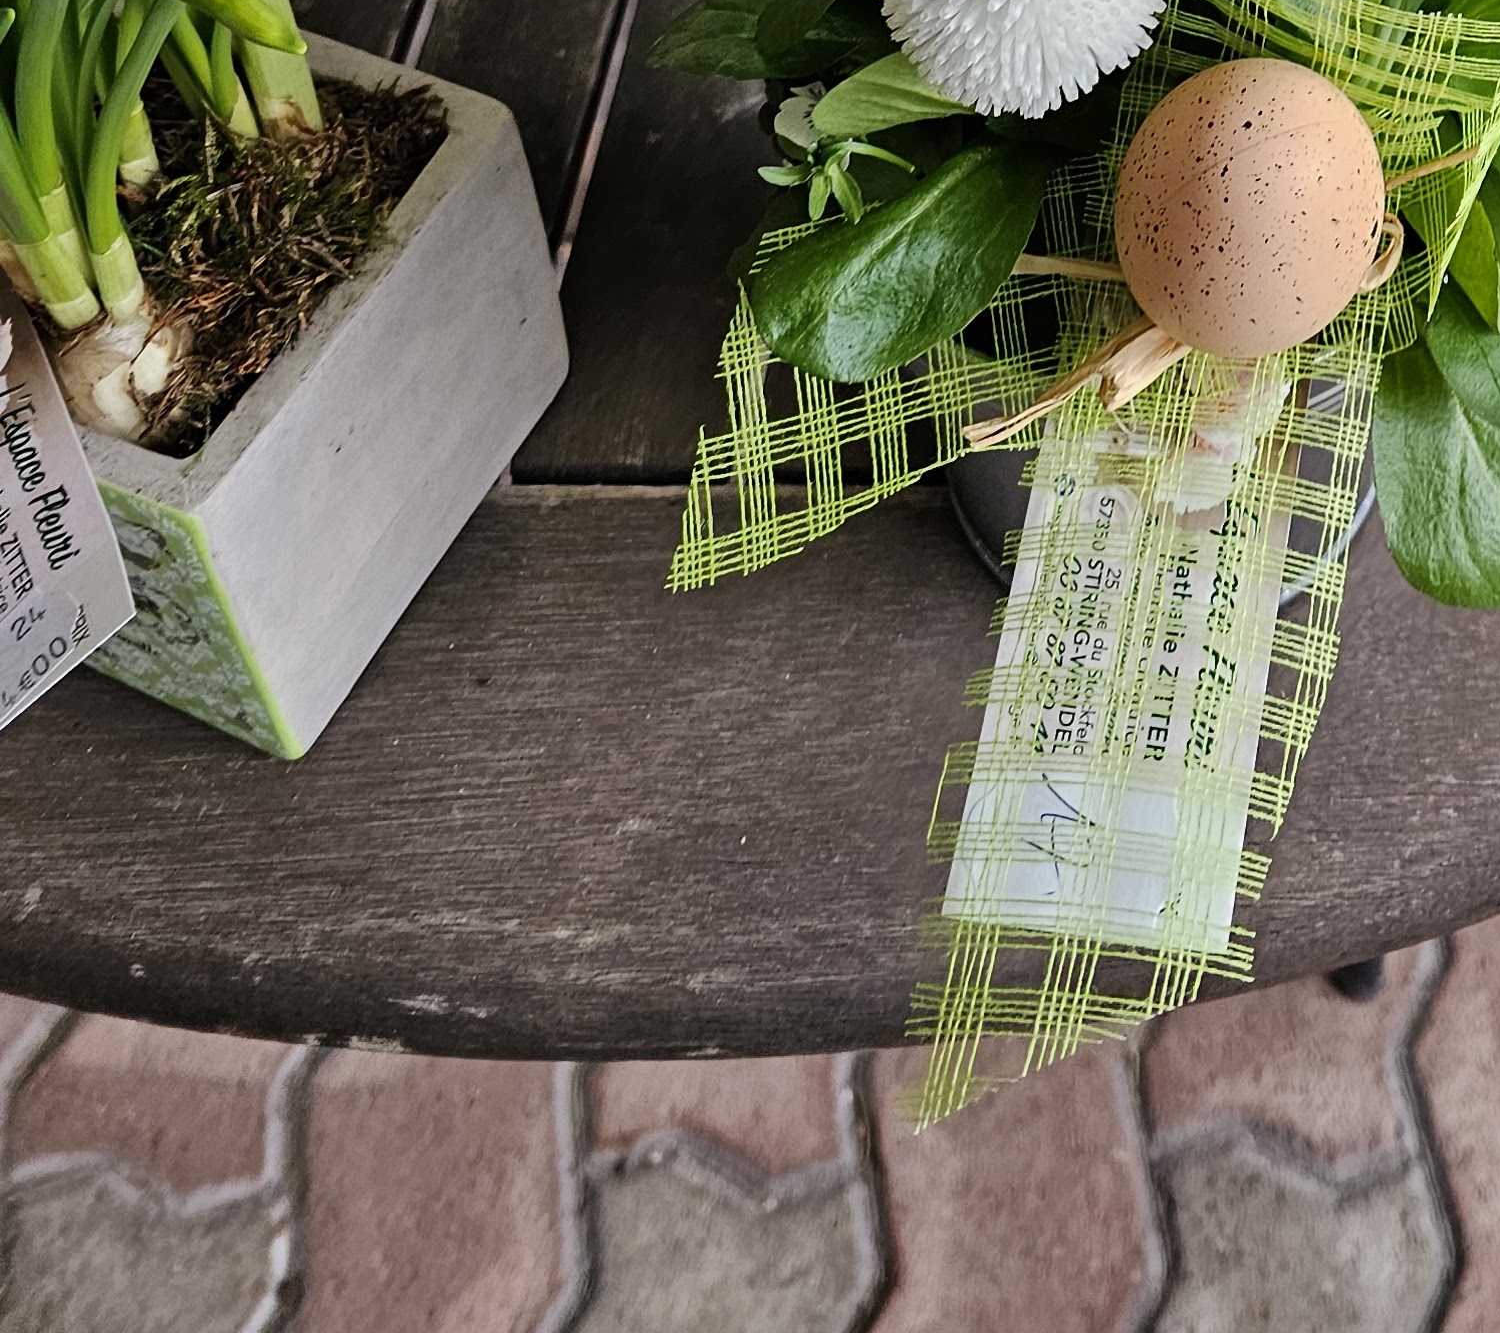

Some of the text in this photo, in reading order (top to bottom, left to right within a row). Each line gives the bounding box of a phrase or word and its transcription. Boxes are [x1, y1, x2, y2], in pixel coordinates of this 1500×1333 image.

[0, 531, 33, 601] ZITTER
[27, 483, 81, 571] Fleuri
[1162, 544, 1200, 654] Nathalie
[1052, 558, 1104, 755] STIRING-WENDEL
[1091, 636, 1109, 663] du
